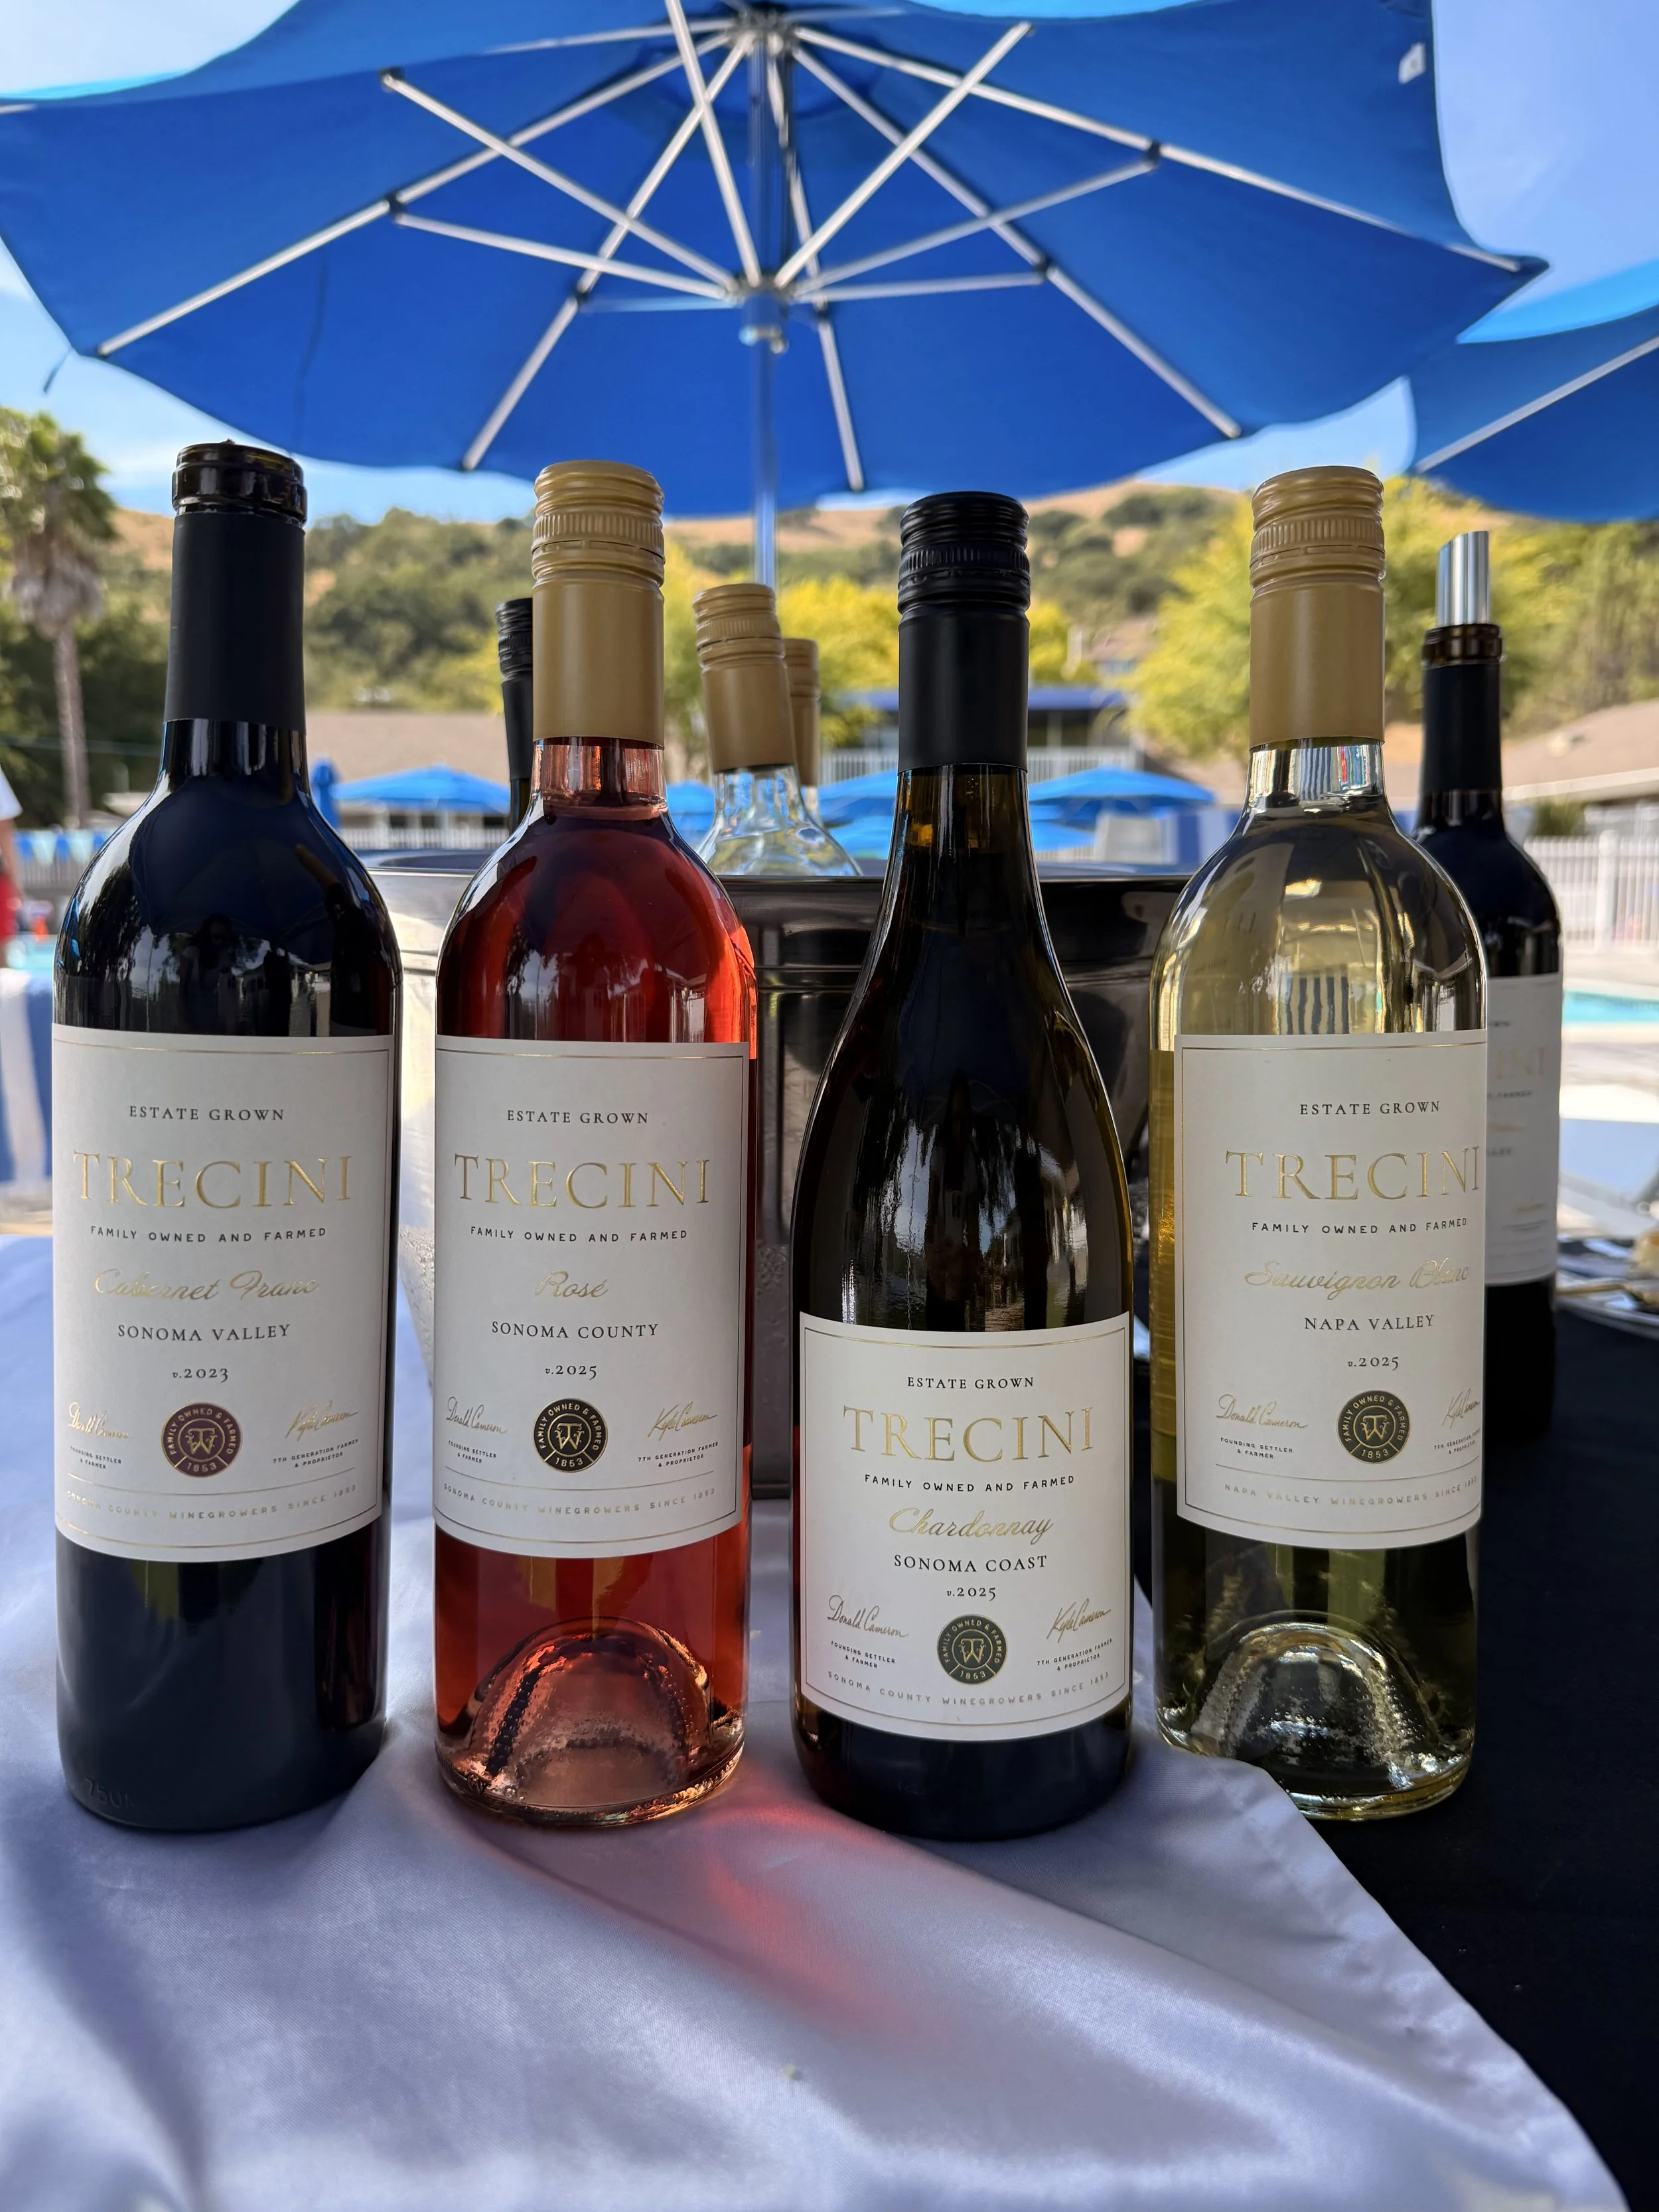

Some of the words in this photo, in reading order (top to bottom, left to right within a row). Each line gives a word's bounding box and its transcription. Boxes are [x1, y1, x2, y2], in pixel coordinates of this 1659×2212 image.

[129, 1105, 199, 1120] ESTATE
[208, 1108, 285, 1121] GROWN
[507, 1110, 571, 1124] ESTATE
[579, 1112, 648, 1124] GROWN
[1299, 1103, 1370, 1115] ESTATE
[1380, 1101, 1440, 1114] GROWN
[73, 1149, 352, 1209] TRECINI
[454, 1153, 710, 1209] TRECINI
[1225, 1145, 1480, 1201] TRECINI
[90, 1225, 137, 1240] FAMILY
[148, 1231, 206, 1242] OWNED
[218, 1232, 252, 1242] AND
[264, 1227, 327, 1241] FARMED
[470, 1226, 514, 1240] FAMILY
[524, 1231, 577, 1242] OWNED
[589, 1232, 619, 1242] AND
[630, 1229, 687, 1242] FARMED
[1252, 1222, 1309, 1234] FAMILY
[1321, 1224, 1378, 1234] OWNED
[1389, 1223, 1417, 1233] AND
[1425, 1217, 1467, 1231] FARMED
[94, 1268, 222, 1301] Cabernet
[230, 1269, 319, 1301] Franc
[534, 1270, 609, 1299] Rosé
[1244, 1261, 1401, 1300] Sauvignon
[117, 1324, 202, 1341] SONOMA
[212, 1323, 291, 1341] VALLEY
[492, 1321, 569, 1339] SONOMA
[577, 1324, 659, 1339] COUNTY
[1304, 1317, 1360, 1331] NAPA
[1368, 1315, 1435, 1330] VALLEY
[907, 1376, 967, 1389] ESTATE
[974, 1376, 1035, 1390] GROWN
[538, 1416, 547, 1449] FAMILY
[547, 1403, 580, 1416] OWNED
[589, 1414, 602, 1451] FARMED
[1342, 1409, 1354, 1442] FAMILY
[1352, 1395, 1385, 1408] OWNED
[1394, 1406, 1406, 1441] FARMED
[167, 1422, 178, 1455] FAMILY
[178, 1408, 213, 1422] OWNED
[223, 1418, 236, 1455] FARMED
[843, 1404, 1094, 1463] TRECINI
[291, 1447, 334, 1460] GENERATION
[337, 1438, 358, 1450] FARMER
[655, 1448, 695, 1460] GENERATION
[698, 1441, 718, 1451] FARMER
[1220, 1437, 1256, 1448] FOUNDING
[1260, 1444, 1293, 1453] SETTLER
[1362, 1449, 1388, 1459] 1853
[303, 1451, 343, 1466] PROPRIETOR
[555, 1457, 583, 1467] 1853
[666, 1453, 704, 1467] PROPRIETOR
[1245, 1450, 1273, 1459] FARMER
[186, 1461, 217, 1473] 1853
[865, 1474, 912, 1489] FAMILY
[922, 1481, 974, 1493] OWNED
[985, 1482, 1013, 1493] AND
[1023, 1475, 1075, 1491] FARMED
[444, 1483, 475, 1502] SONOMA
[538, 1504, 639, 1515] WINEGROWERS
[650, 1496, 685, 1509] SINCE
[1224, 1484, 1256, 1497] NAPA
[1267, 1492, 1319, 1504] VALLEY
[1331, 1493, 1427, 1505] WINEGROWERS
[1435, 1485, 1461, 1497] SINCE
[170, 1505, 277, 1519] WINEGROWERS
[288, 1495, 326, 1510] SINCE
[888, 1507, 1054, 1546] Chardonnay
[894, 1554, 977, 1573] SONOMA
[985, 1555, 1048, 1572] COAST
[942, 1632, 951, 1663] FAMILY
[952, 1619, 981, 1631] OWNED
[991, 1629, 1002, 1664] FARMED
[831, 1640, 861, 1655] FOUNDING
[865, 1652, 895, 1664] SETTLER
[1054, 1648, 1092, 1663] GENERATION
[1064, 1653, 1100, 1669] PROPRIETOR
[852, 1657, 877, 1668] FARMER
[960, 1670, 985, 1680] 1853
[828, 1670, 871, 1692] SONOMA
[879, 1688, 930, 1703] COUNTY
[942, 1694, 1042, 1706] WINEGROWERS
[1051, 1682, 1084, 1697] SINCE
